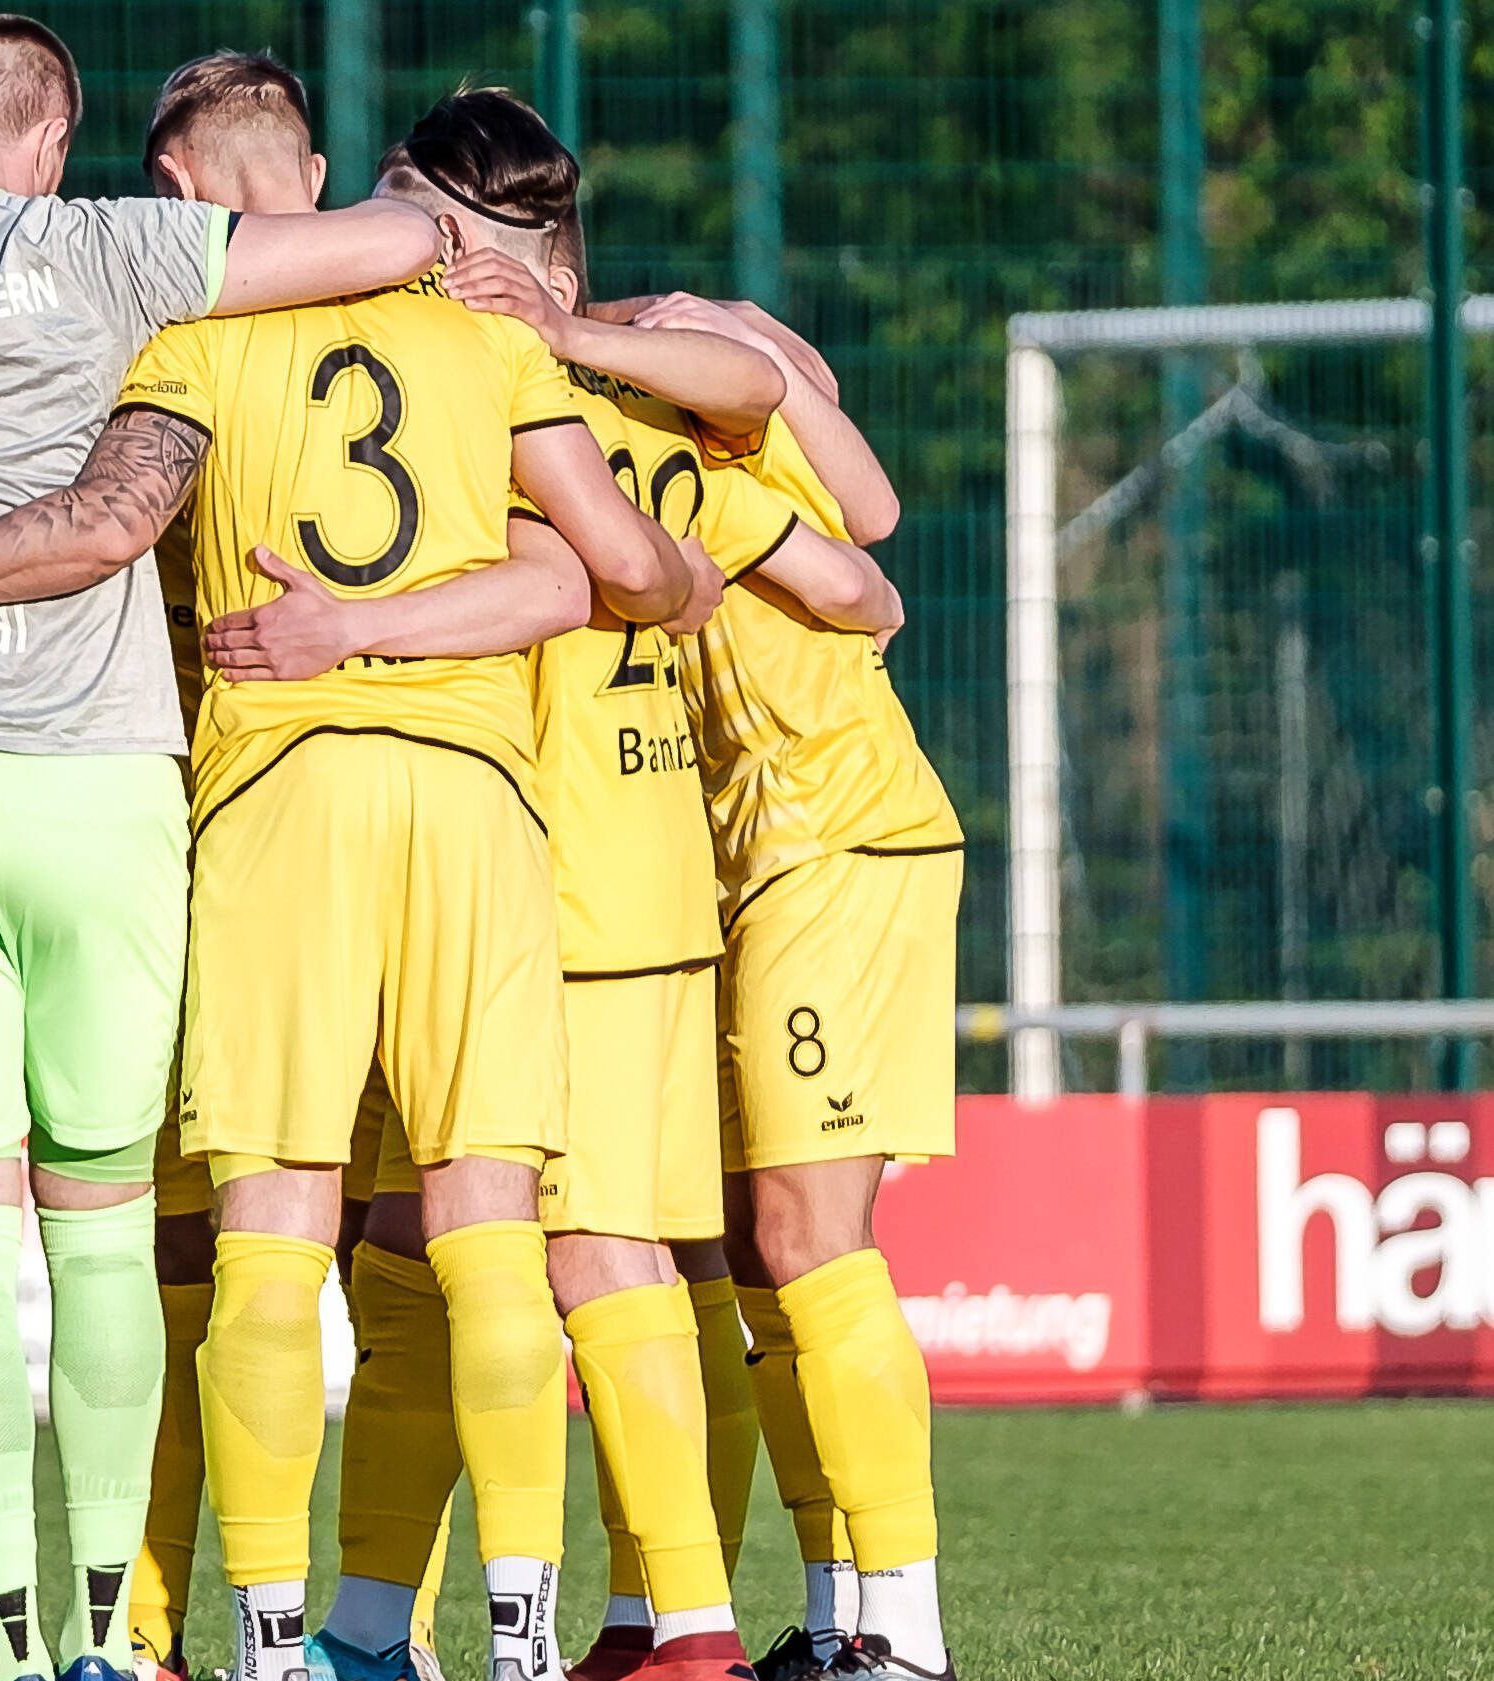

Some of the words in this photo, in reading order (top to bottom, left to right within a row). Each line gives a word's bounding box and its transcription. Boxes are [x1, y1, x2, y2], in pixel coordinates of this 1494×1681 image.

[296, 341, 420, 588] 3
[787, 1006, 826, 1077] 8
[820, 1113, 864, 1132] erima
